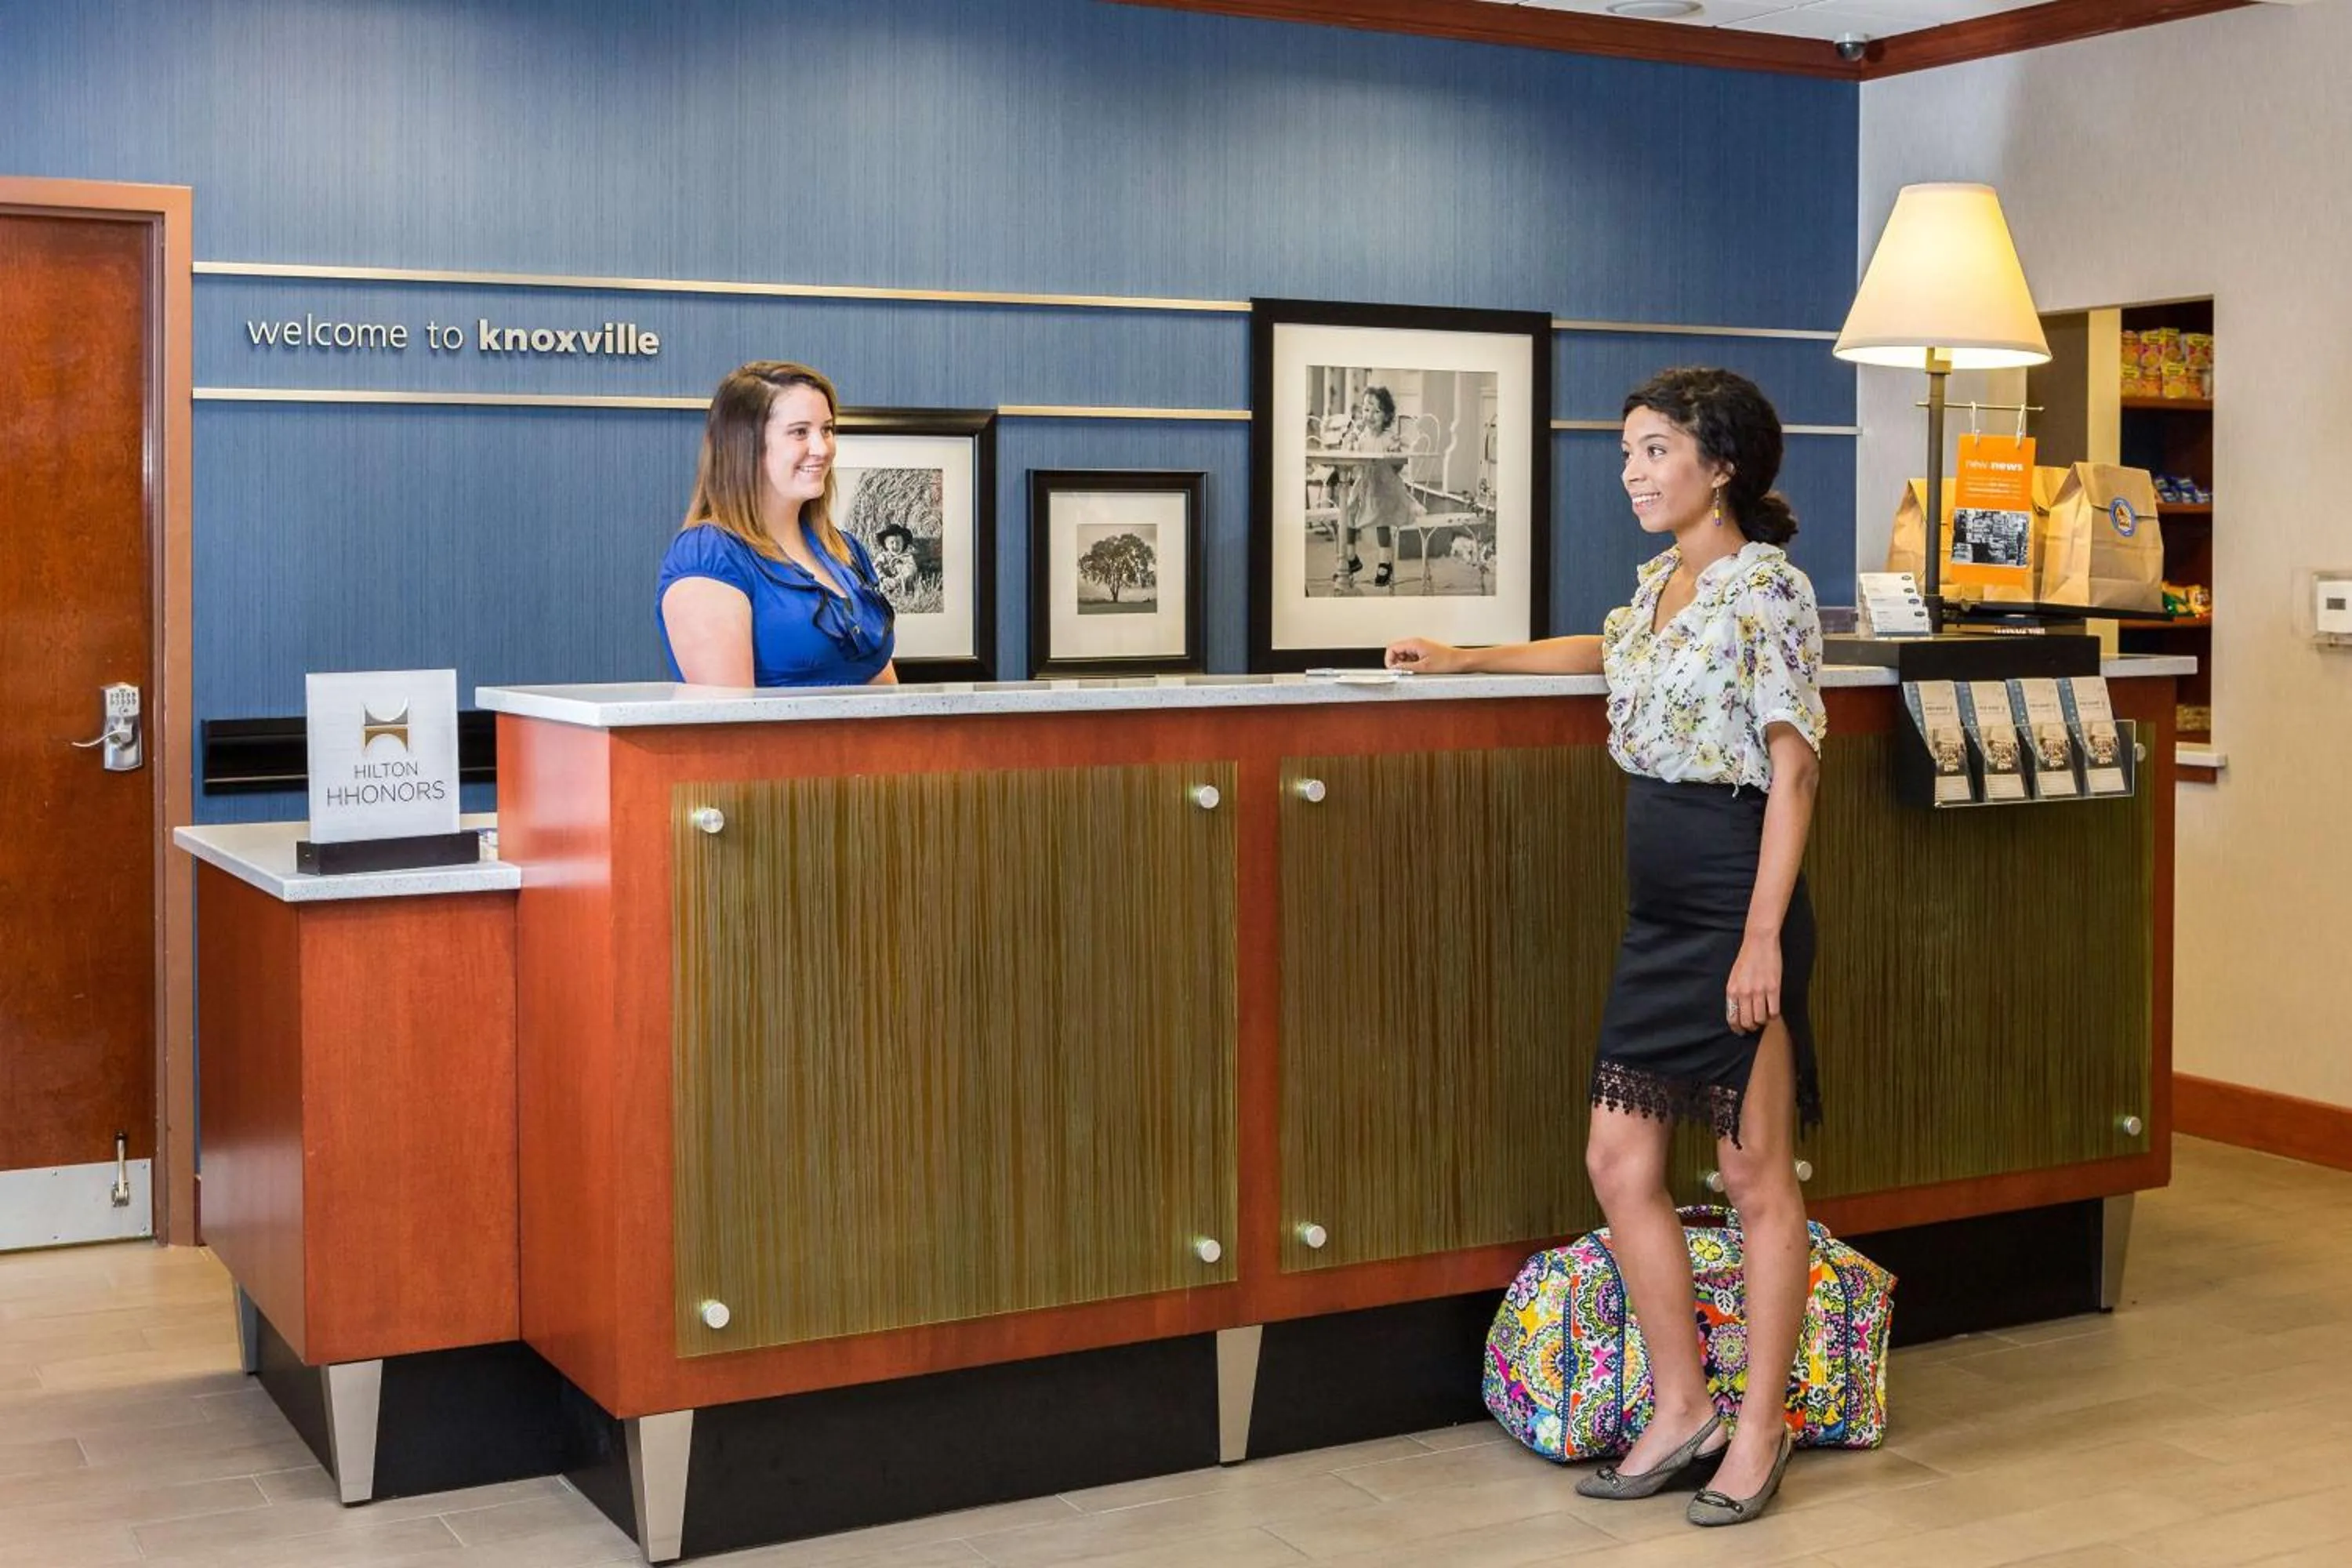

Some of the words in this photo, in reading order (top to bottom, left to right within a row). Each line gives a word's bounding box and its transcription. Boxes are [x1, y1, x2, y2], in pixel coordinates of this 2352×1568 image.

[247, 314, 408, 349] welcome
[426, 320, 463, 350] to
[478, 318, 660, 355] knoxville
[1990, 462, 2024, 471] news
[354, 762, 419, 779] HILTON
[327, 781, 445, 806] HHONORS
